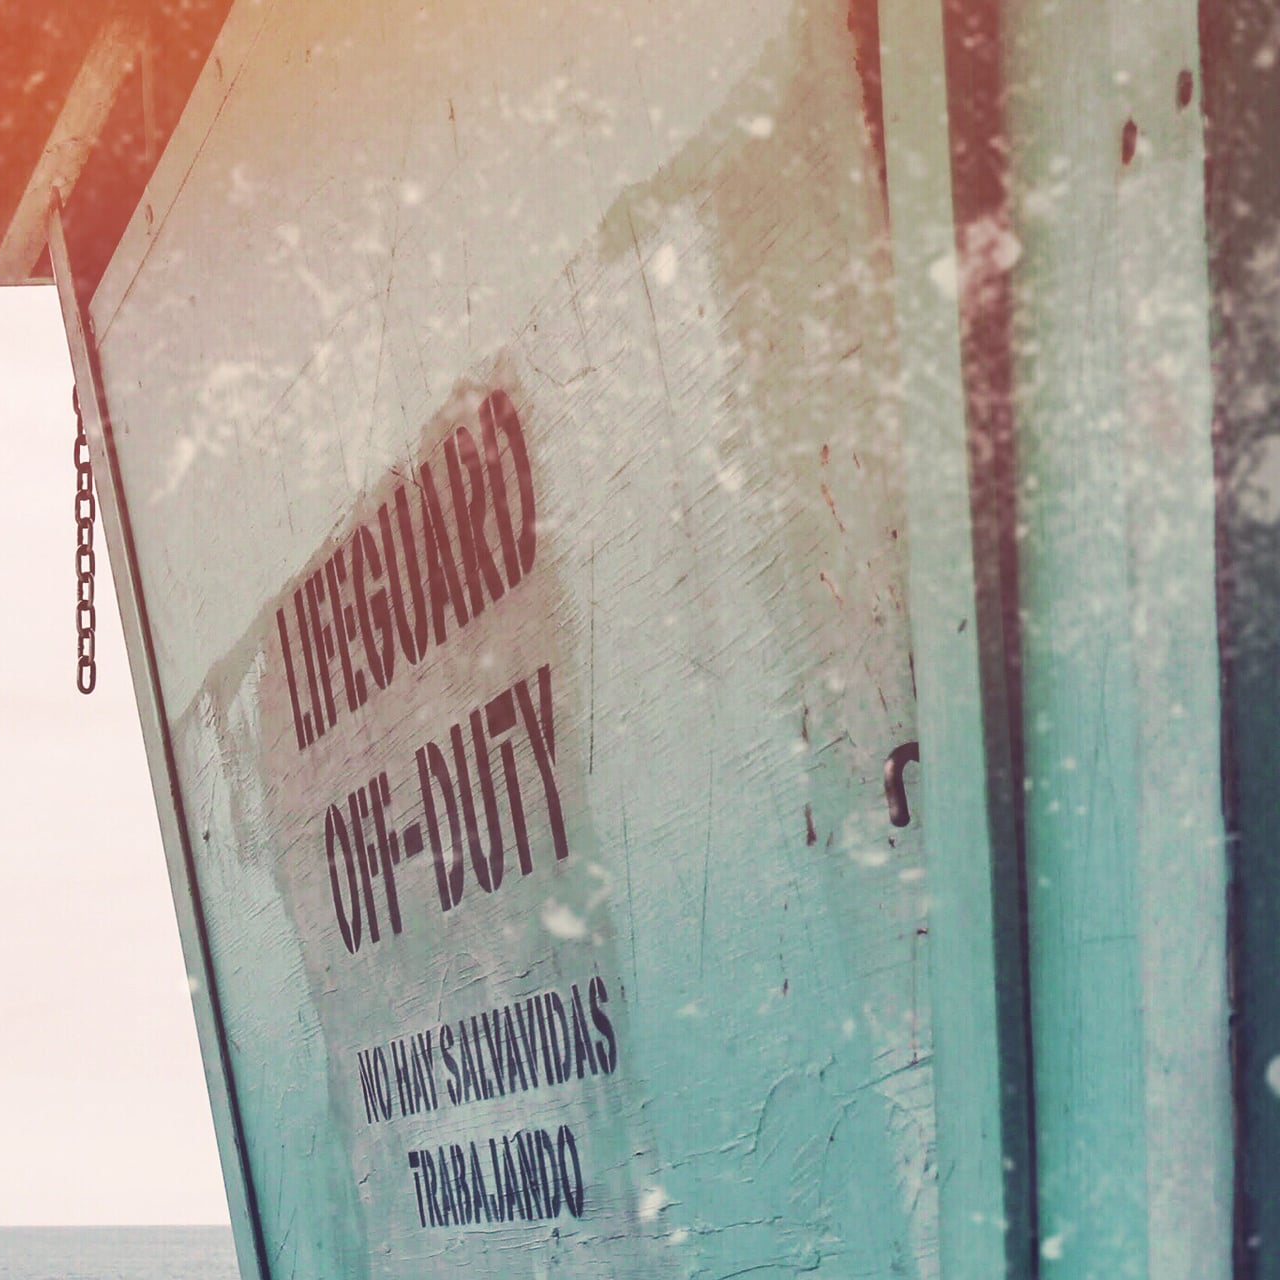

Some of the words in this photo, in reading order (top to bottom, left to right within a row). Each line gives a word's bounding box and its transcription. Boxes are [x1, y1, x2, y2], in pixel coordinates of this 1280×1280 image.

[276, 389, 537, 751] LIFEGUARD
[325, 664, 569, 955] OFF-DUTY
[358, 1047, 392, 1124] NO
[391, 1030, 438, 1117] HAY
[440, 976, 618, 1106] SALVAVIDAS
[408, 1125, 585, 1228] TRABAJANDO
